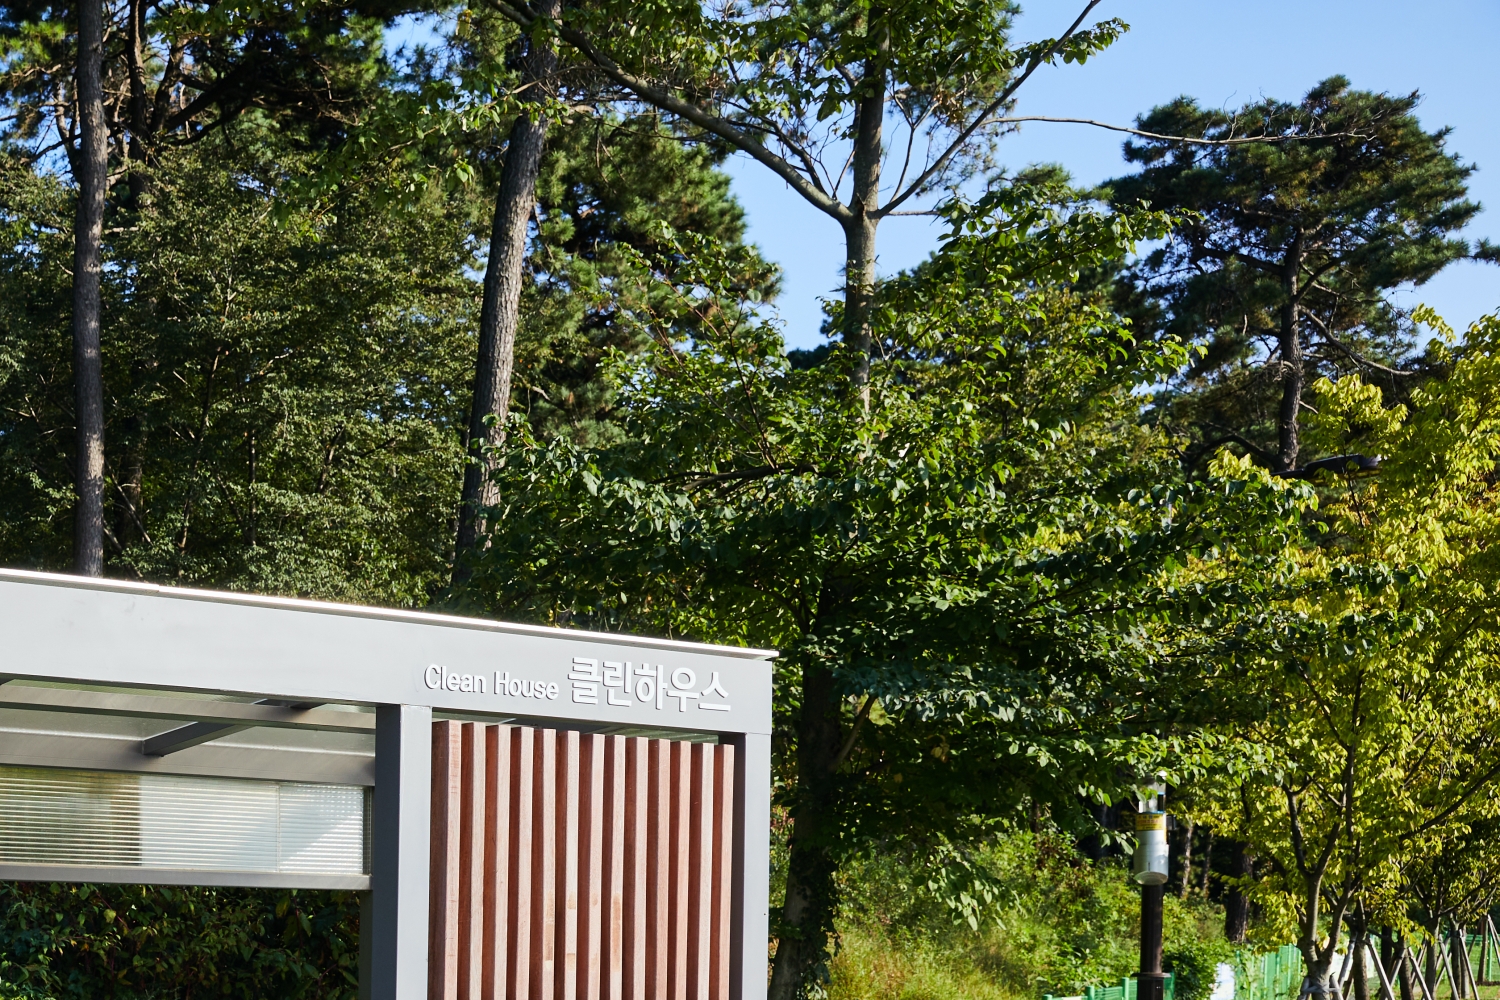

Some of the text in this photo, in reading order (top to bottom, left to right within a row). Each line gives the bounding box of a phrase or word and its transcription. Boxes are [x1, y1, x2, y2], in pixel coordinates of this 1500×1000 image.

[424, 663, 559, 700] Clean House
[568, 657, 731, 712] 클린하우스
